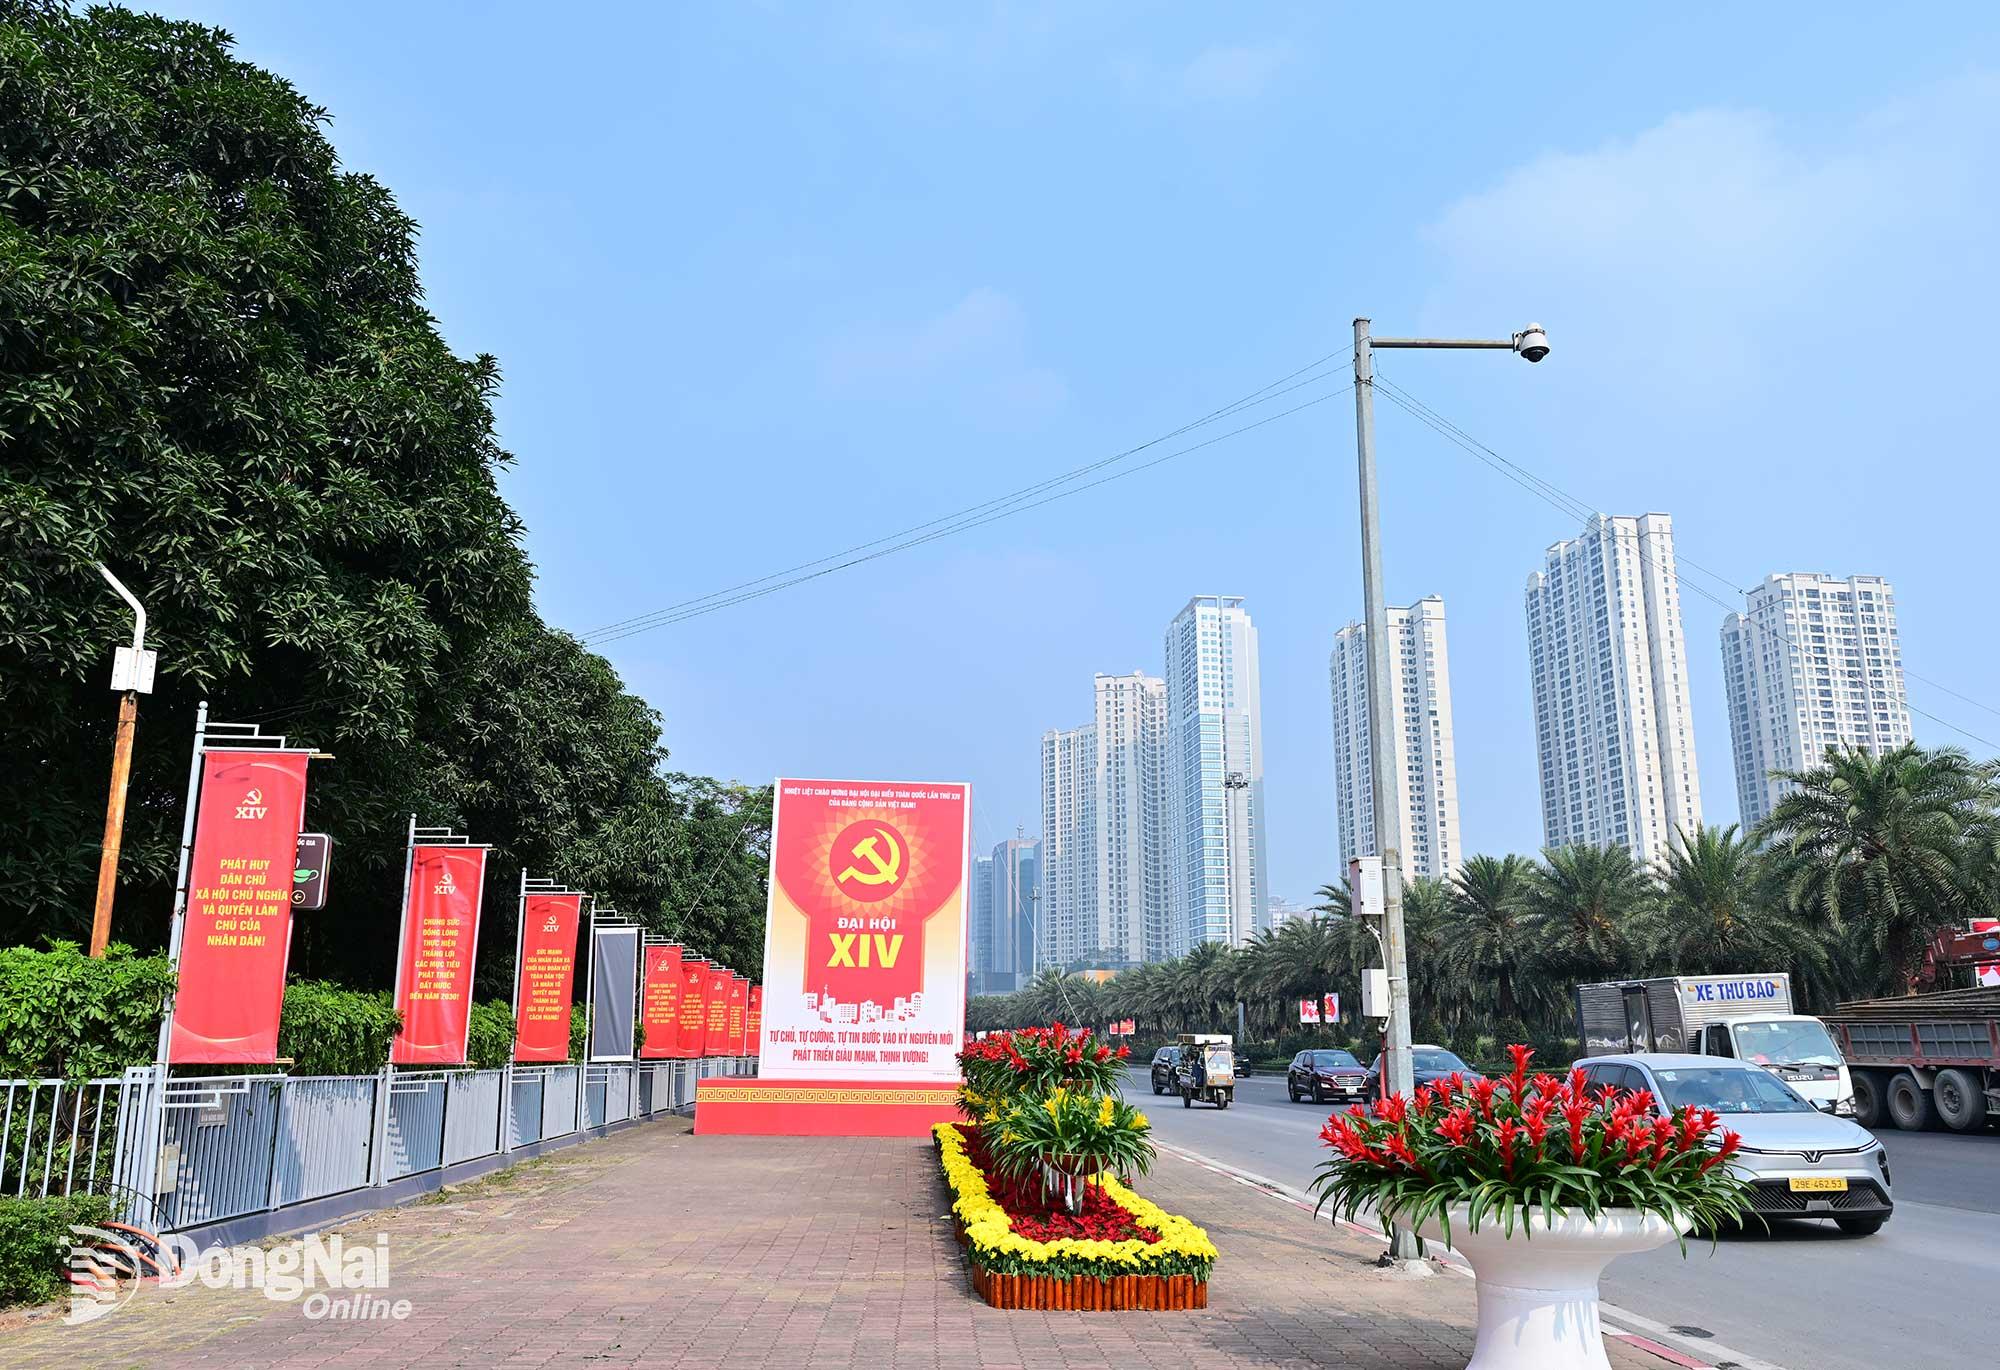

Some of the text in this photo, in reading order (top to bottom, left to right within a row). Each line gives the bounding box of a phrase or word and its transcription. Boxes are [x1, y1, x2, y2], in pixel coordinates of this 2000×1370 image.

[235, 806, 268, 820] XIV
[220, 858, 270, 870] PHÁT HUY
[220, 872, 266, 885] DÂN CHỦ
[195, 887, 288, 902] XÃ HỘI CHỦ NGHĨA
[434, 885, 456, 895] XIV
[202, 902, 278, 916] VÀ QUYỀN LÀM
[215, 917, 261, 931] CHỦ CỦA
[837, 916, 896, 932] ĐẠI HỘI
[207, 934, 266, 946] NHÂN DÂN!
[826, 933, 904, 968] XIV
[1695, 984, 1714, 1001] XE
[1717, 981, 1744, 1000] THƯ
[770, 1026, 953, 1046] TỰ CHỦ, TỰ CƯỜNG, TỰ TIN BƯỚC VÀO KỶ NGUYÊN MỚI
[793, 1045, 928, 1065] PHÁT TRIỂN GIÀU MẠNH, THỊNH VƯỢNG!
[1795, 1180, 1842, 1189] 29E-462.53
